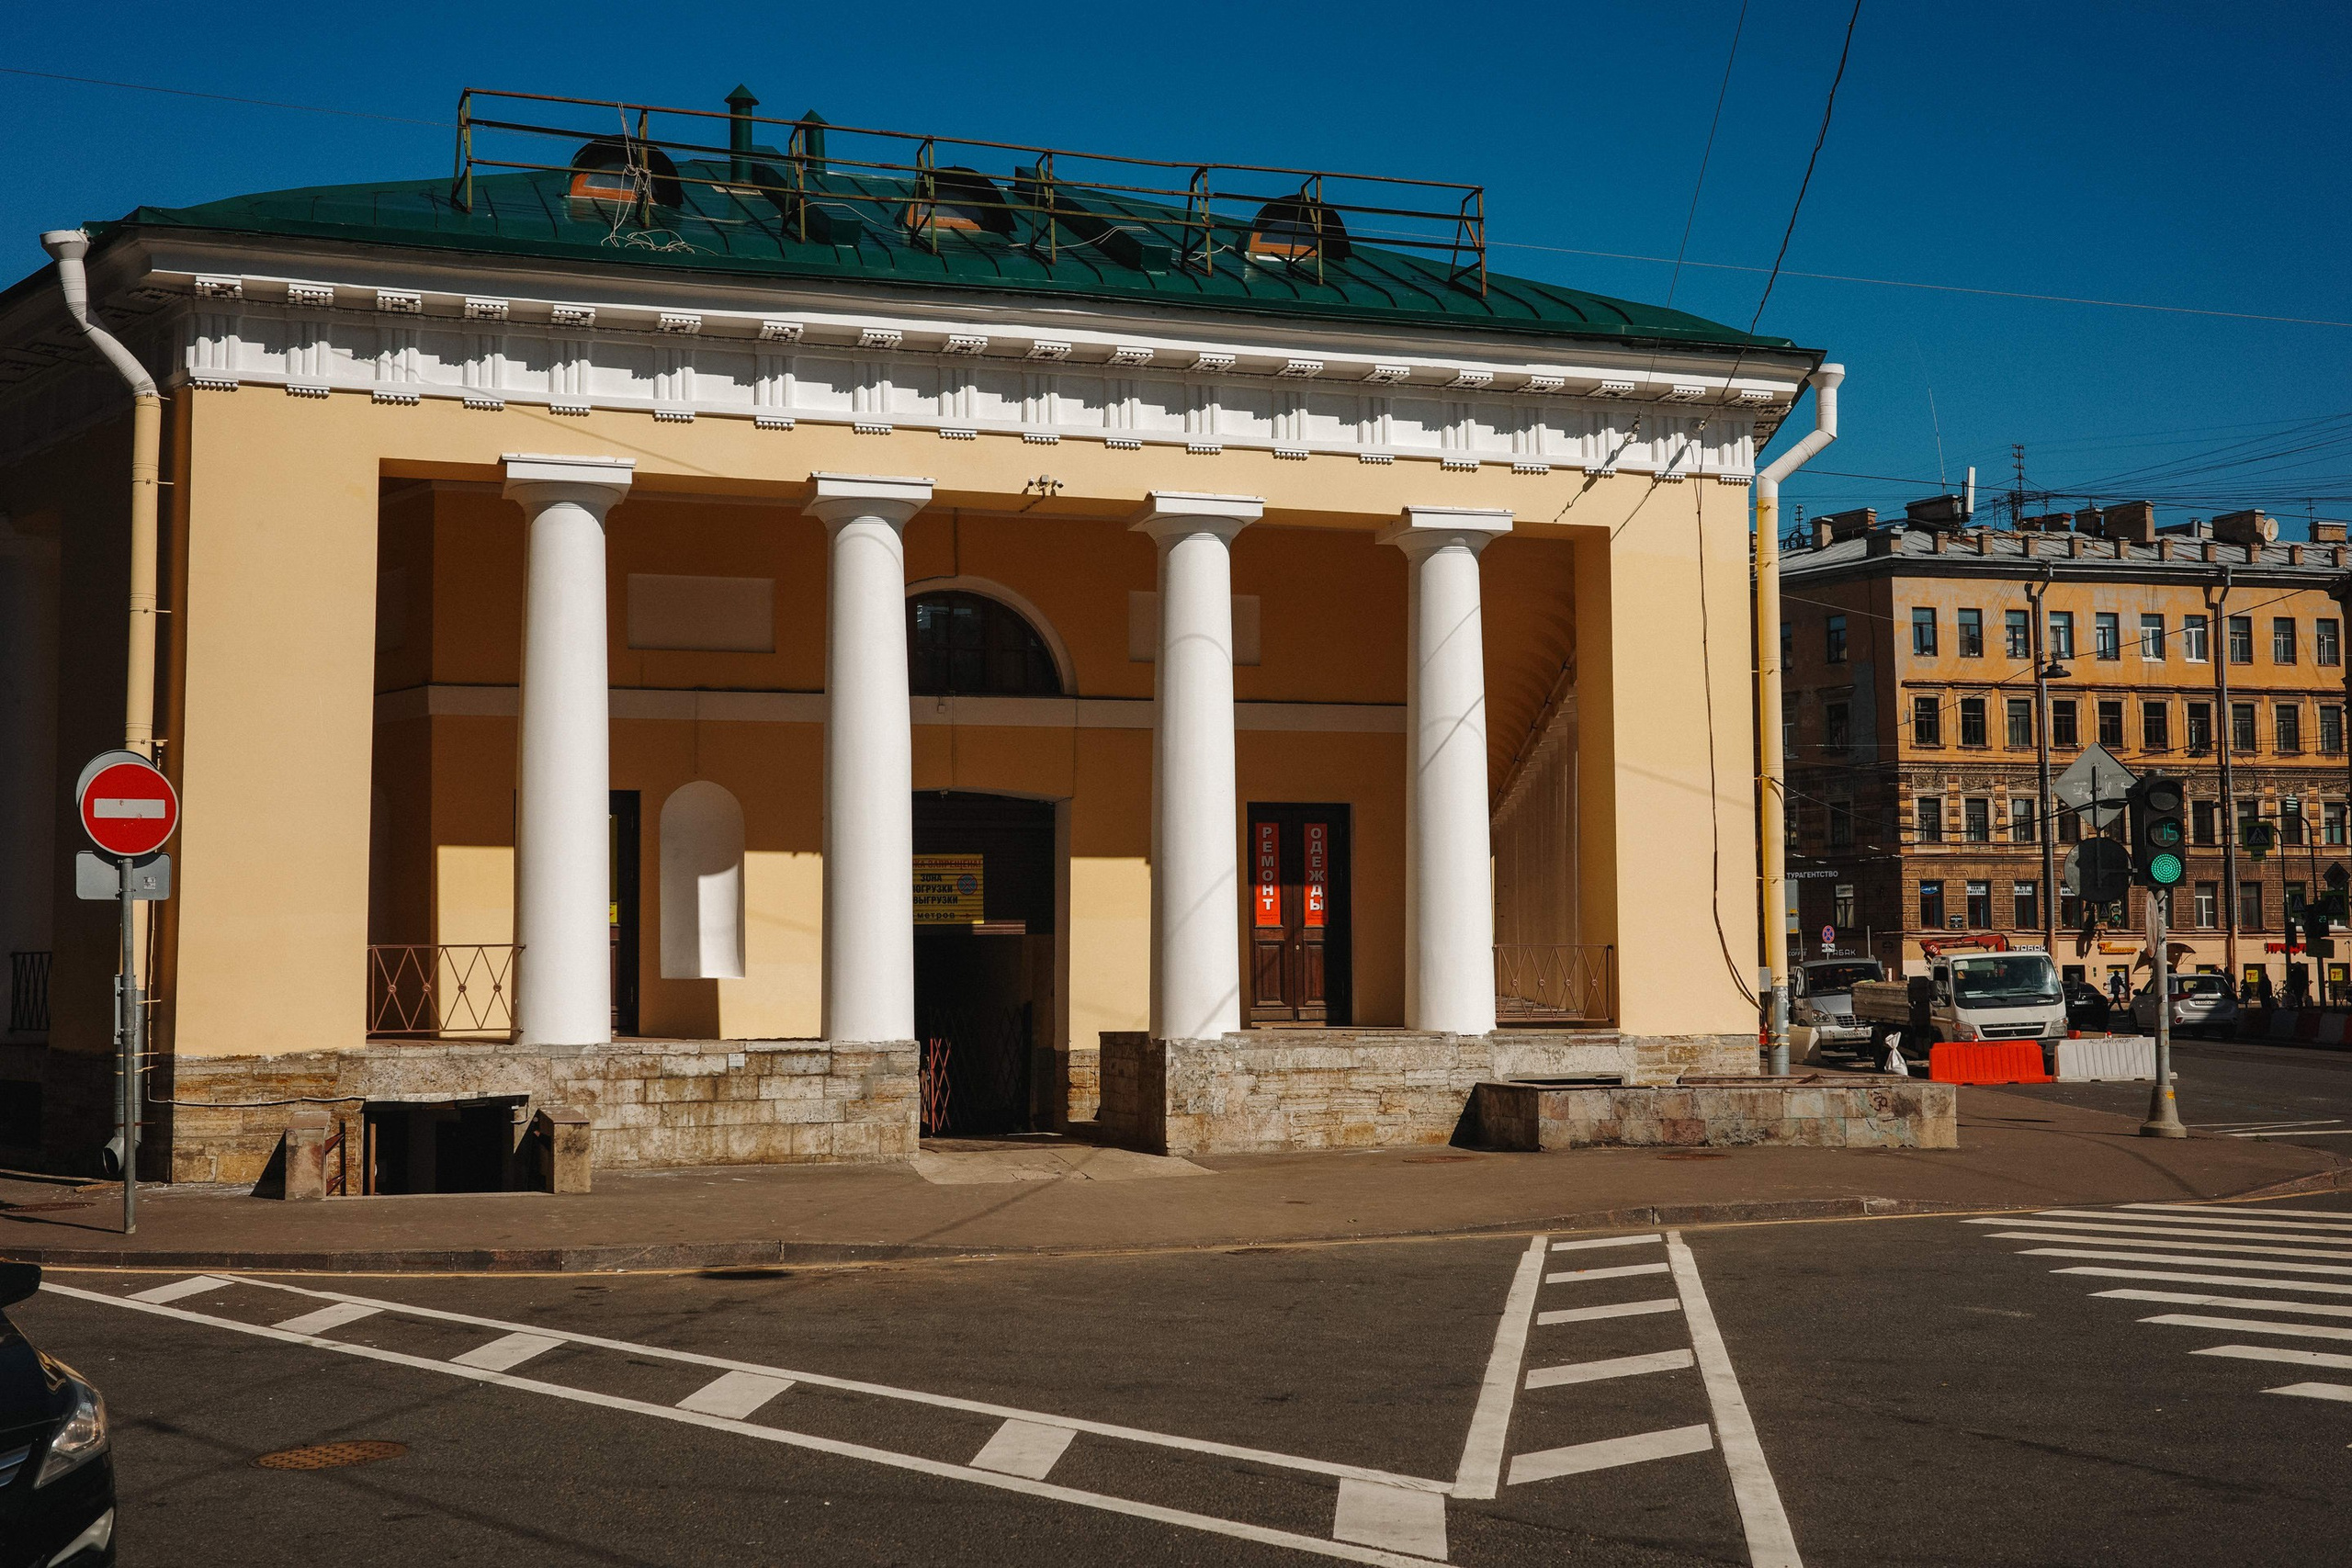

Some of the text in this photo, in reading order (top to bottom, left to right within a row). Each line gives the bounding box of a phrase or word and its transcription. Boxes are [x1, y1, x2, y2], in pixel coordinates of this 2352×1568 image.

[2163, 822, 2179, 840] 15
[1261, 827, 1274, 910] РЕМОНТ
[1308, 828, 1325, 911] ОДЕЖДЫ
[1786, 871, 1838, 879] ТУРАГЕНТСТВО
[913, 896, 958, 904] ВЫГРУЗКИ
[917, 912, 956, 920] метров
[2318, 915, 2327, 923] 23
